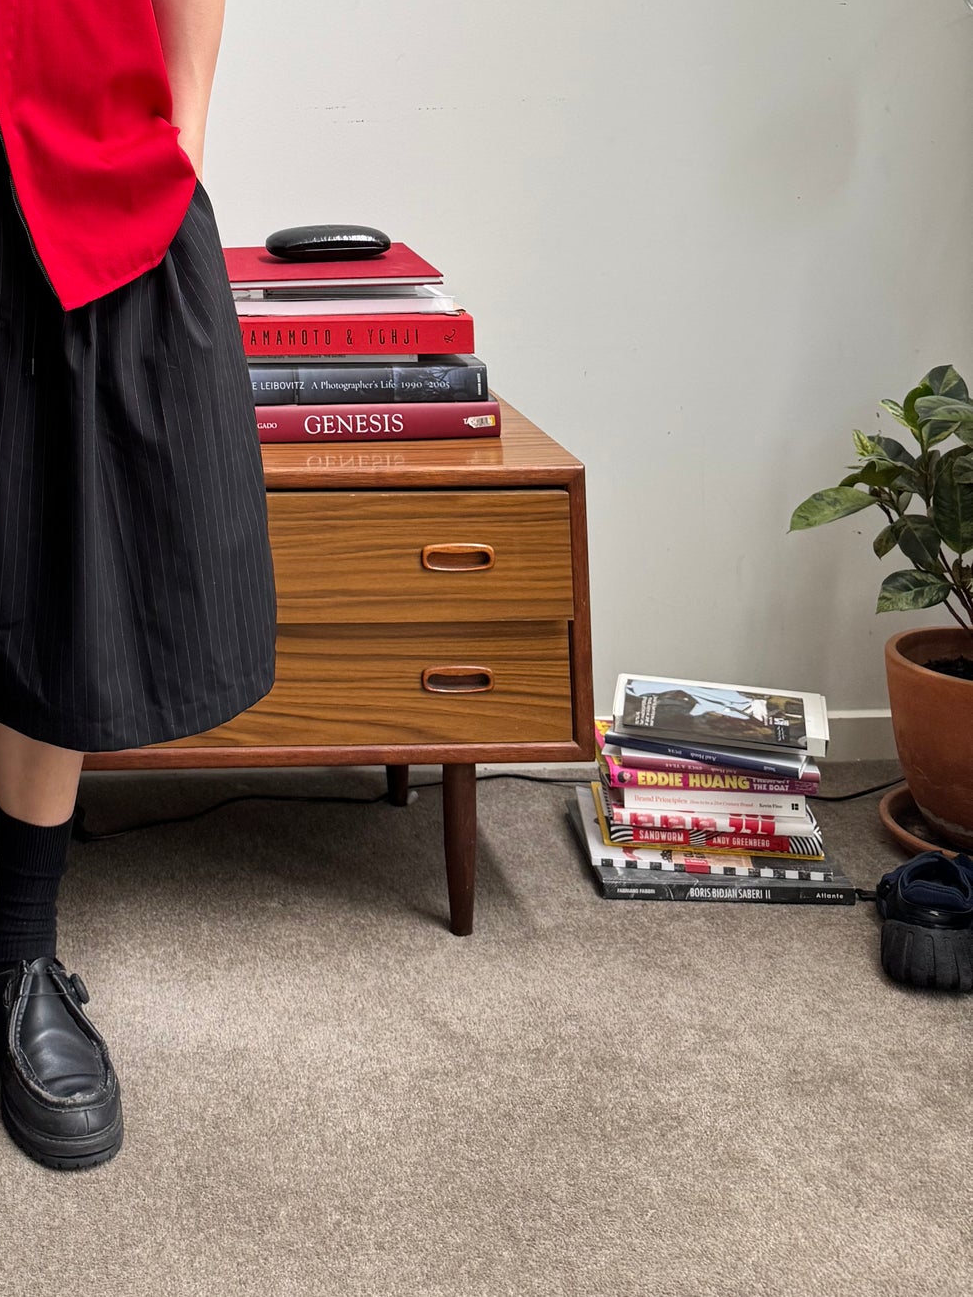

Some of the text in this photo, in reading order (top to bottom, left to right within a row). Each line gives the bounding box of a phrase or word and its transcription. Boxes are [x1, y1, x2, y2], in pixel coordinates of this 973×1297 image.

[260, 381, 305, 391] LEIBOVITZ
[311, 381, 318, 390] A
[320, 380, 379, 392] Photographer's
[380, 379, 396, 389] Life
[401, 381, 423, 389] 1990
[304, 413, 404, 435] GENESIS
[637, 770, 751, 790] EDDIE HUANG
[768, 784, 790, 792] BOAT
[639, 829, 770, 848] SANDWORM ANDY GREENBERG
[689, 887, 711, 899] BORIS
[711, 888, 738, 900] BIDJAN
[738, 889, 763, 901] SABERI
